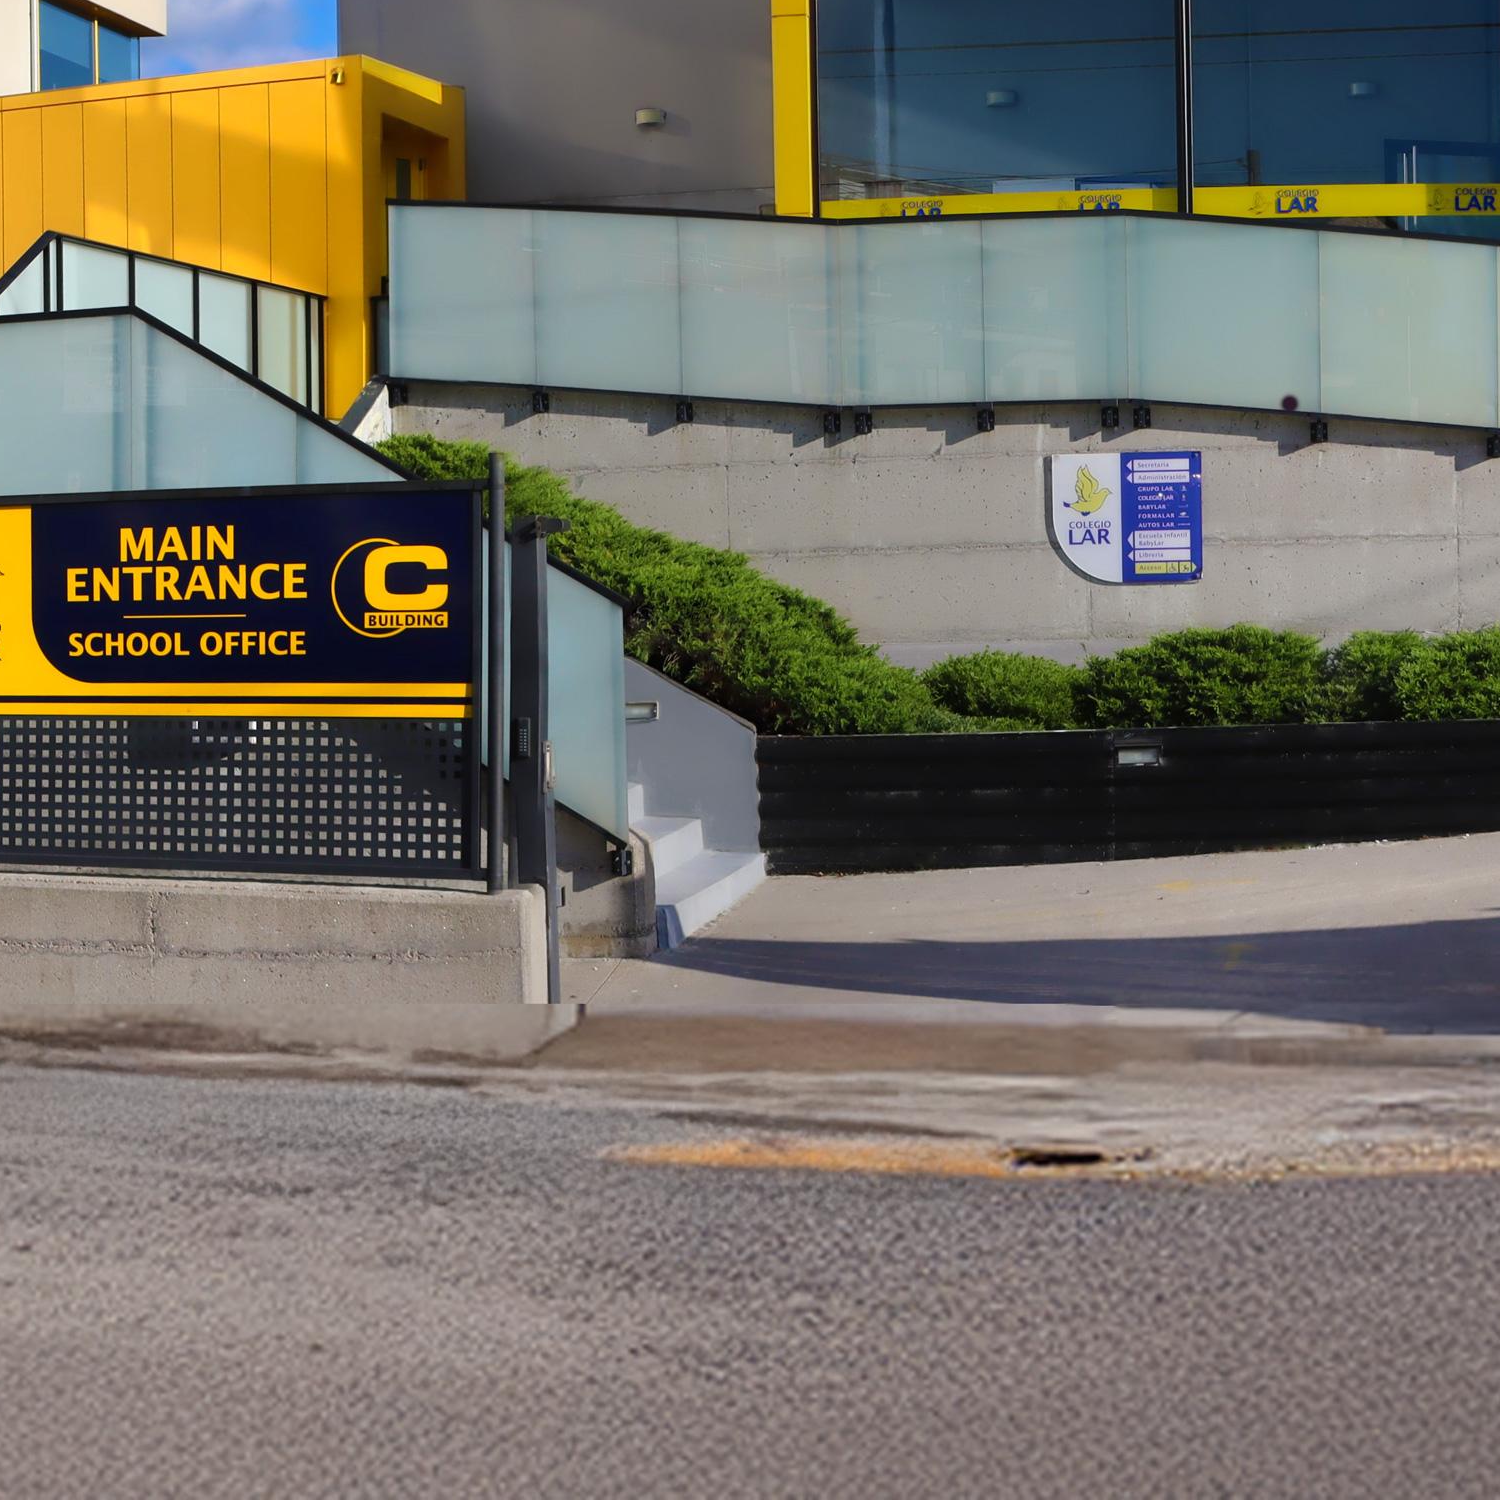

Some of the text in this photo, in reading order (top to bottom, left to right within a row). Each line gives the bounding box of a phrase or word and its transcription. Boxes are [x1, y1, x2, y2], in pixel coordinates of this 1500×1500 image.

[1077, 193, 1122, 204] COLEGIO
[1276, 188, 1319, 198] COLEGIO
[1455, 187, 1497, 197] COLEGIO
[901, 199, 943, 209] COLEGIO
[1275, 196, 1319, 214] LAR
[1454, 195, 1497, 213] LAR
[1068, 520, 1112, 529] COLEGIO
[118, 524, 236, 564] MAIN
[1068, 529, 1111, 546] LAR
[65, 562, 308, 603] ENTRANCE
[363, 544, 449, 611] C
[367, 613, 446, 628] BUILDING
[67, 630, 308, 658] SCHOOL OFFICE
